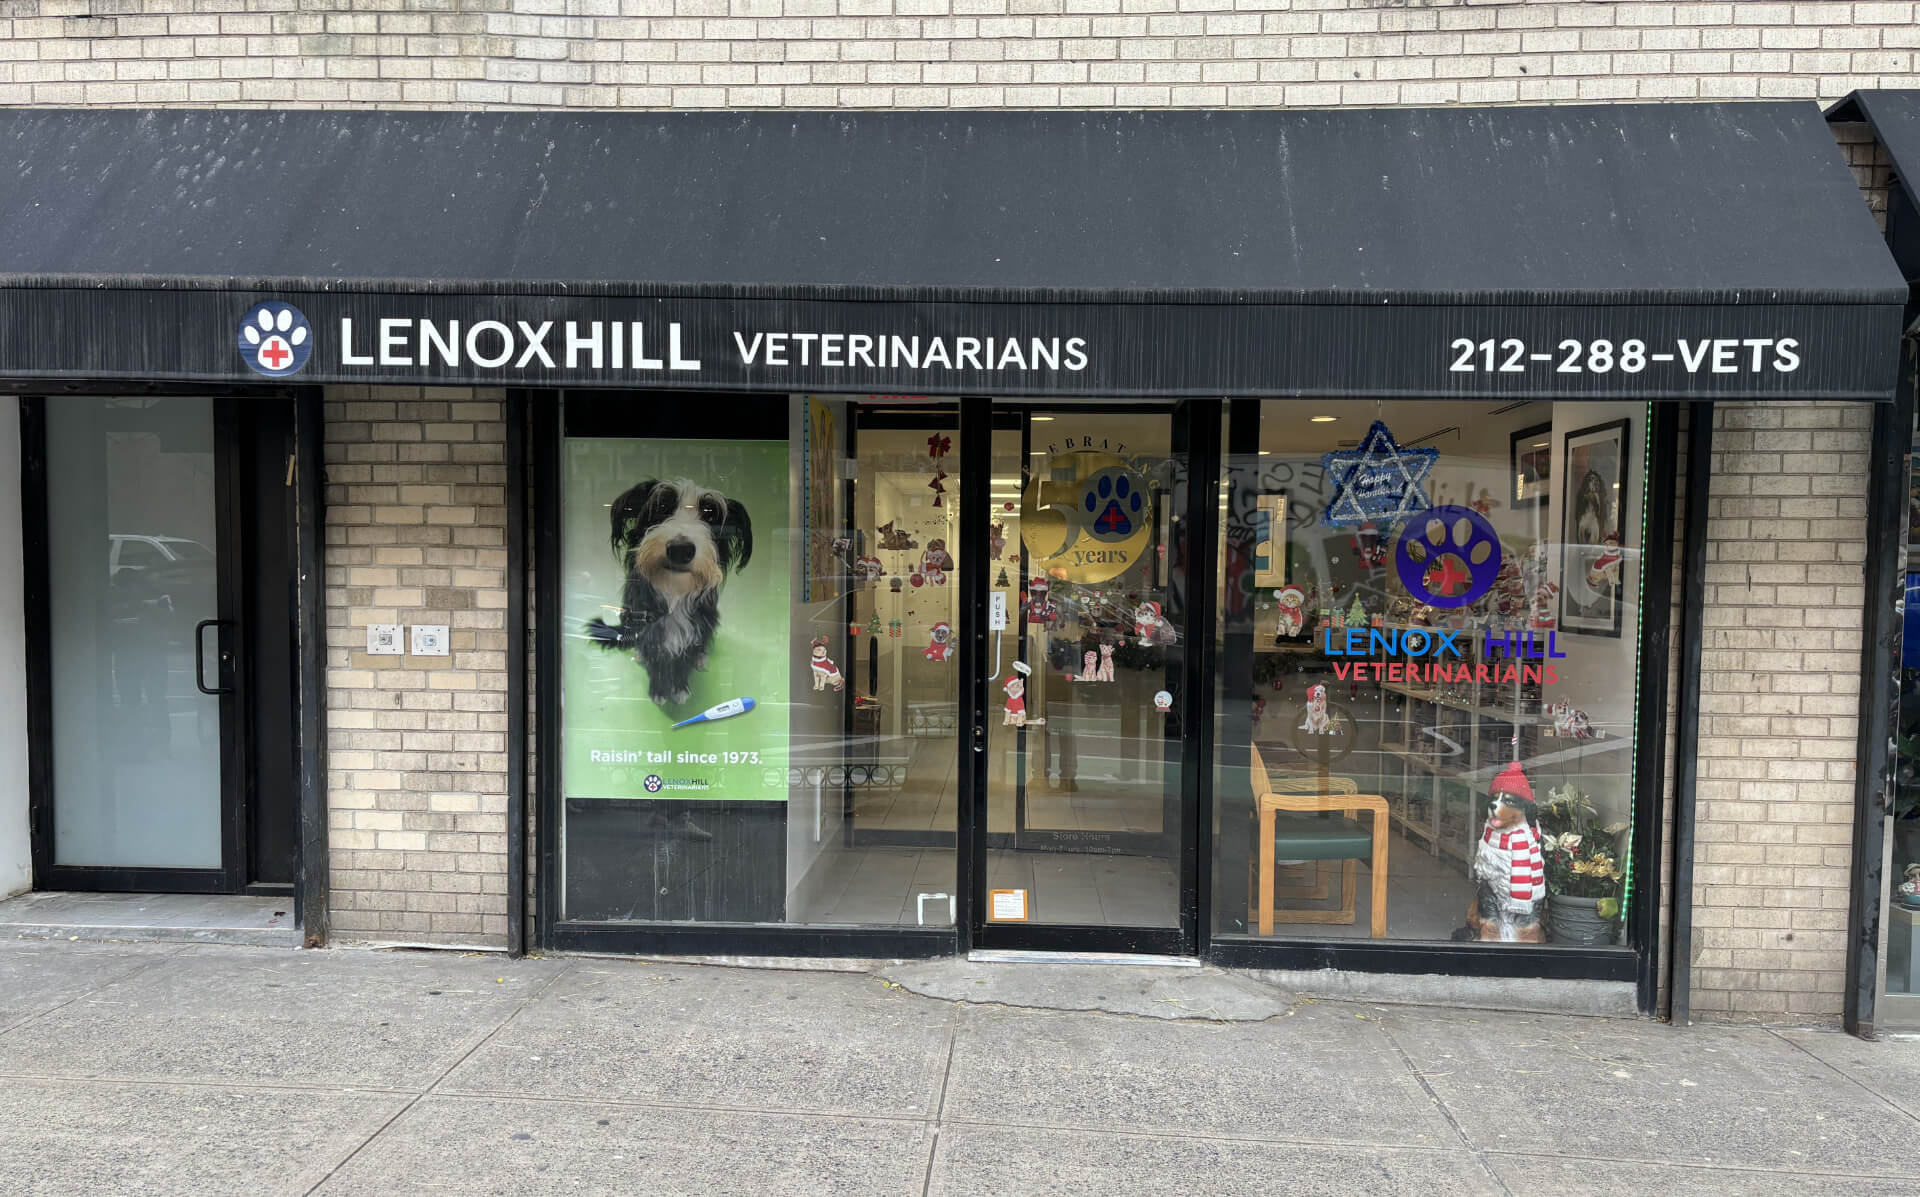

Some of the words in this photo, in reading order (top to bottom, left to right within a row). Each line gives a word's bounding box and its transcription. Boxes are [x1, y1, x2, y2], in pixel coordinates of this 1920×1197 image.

[733, 331, 1089, 371] VETERINARIANS
[1449, 337, 1801, 374] 212-288-VETS
[1358, 471, 1392, 488] Happy
[1072, 549, 1128, 568] years
[1324, 628, 1462, 657] LENOX
[1484, 629, 1566, 658] HILL
[1332, 661, 1558, 684] VETERINARIANS
[647, 751, 672, 763] tail
[676, 751, 718, 764] since
[723, 752, 763, 765] 1973.
